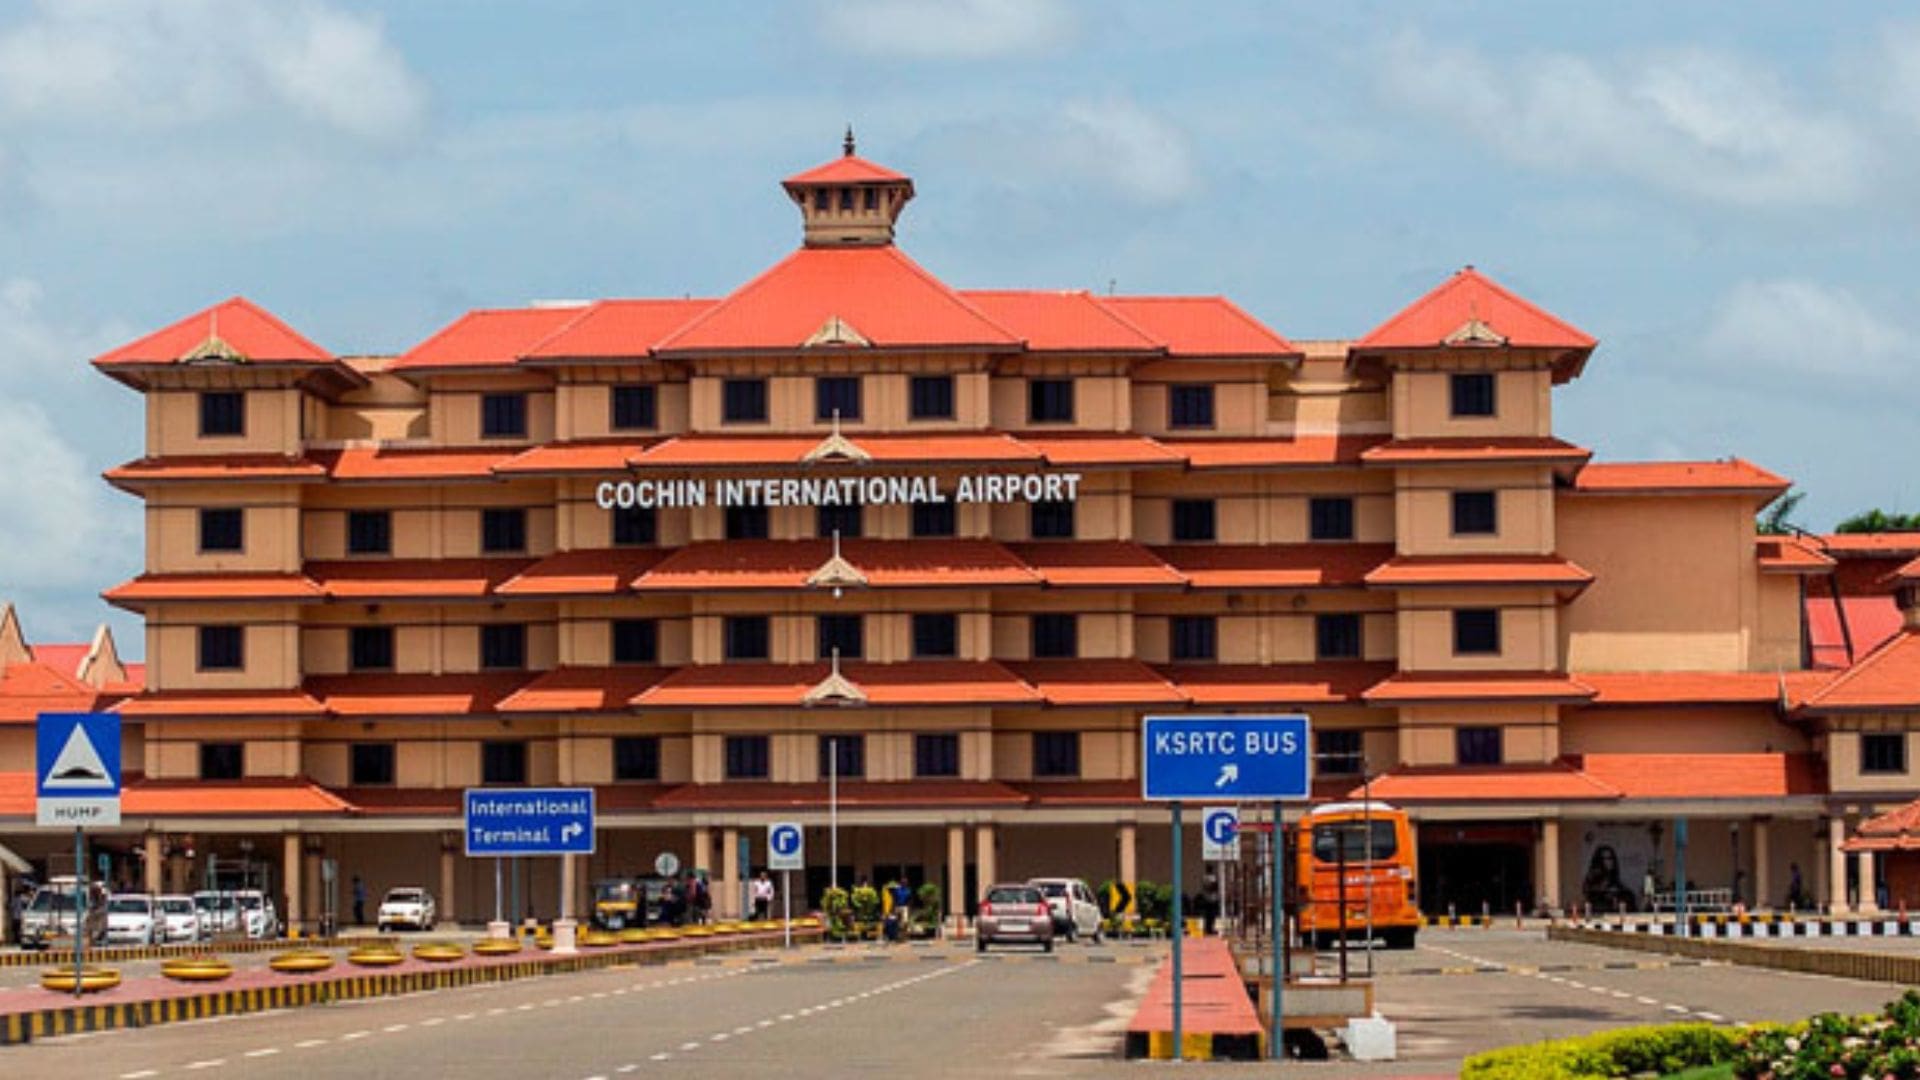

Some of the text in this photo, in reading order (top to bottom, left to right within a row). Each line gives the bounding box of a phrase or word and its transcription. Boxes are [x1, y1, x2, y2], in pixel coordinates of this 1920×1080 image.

[596, 473, 1080, 509] COCHIN INTERNATIONAL AIRPORT
[1155, 731, 1298, 755] KSRTC BUS
[55, 806, 102, 819] HUMP
[471, 798, 588, 815] International
[472, 826, 551, 843] Terminal
